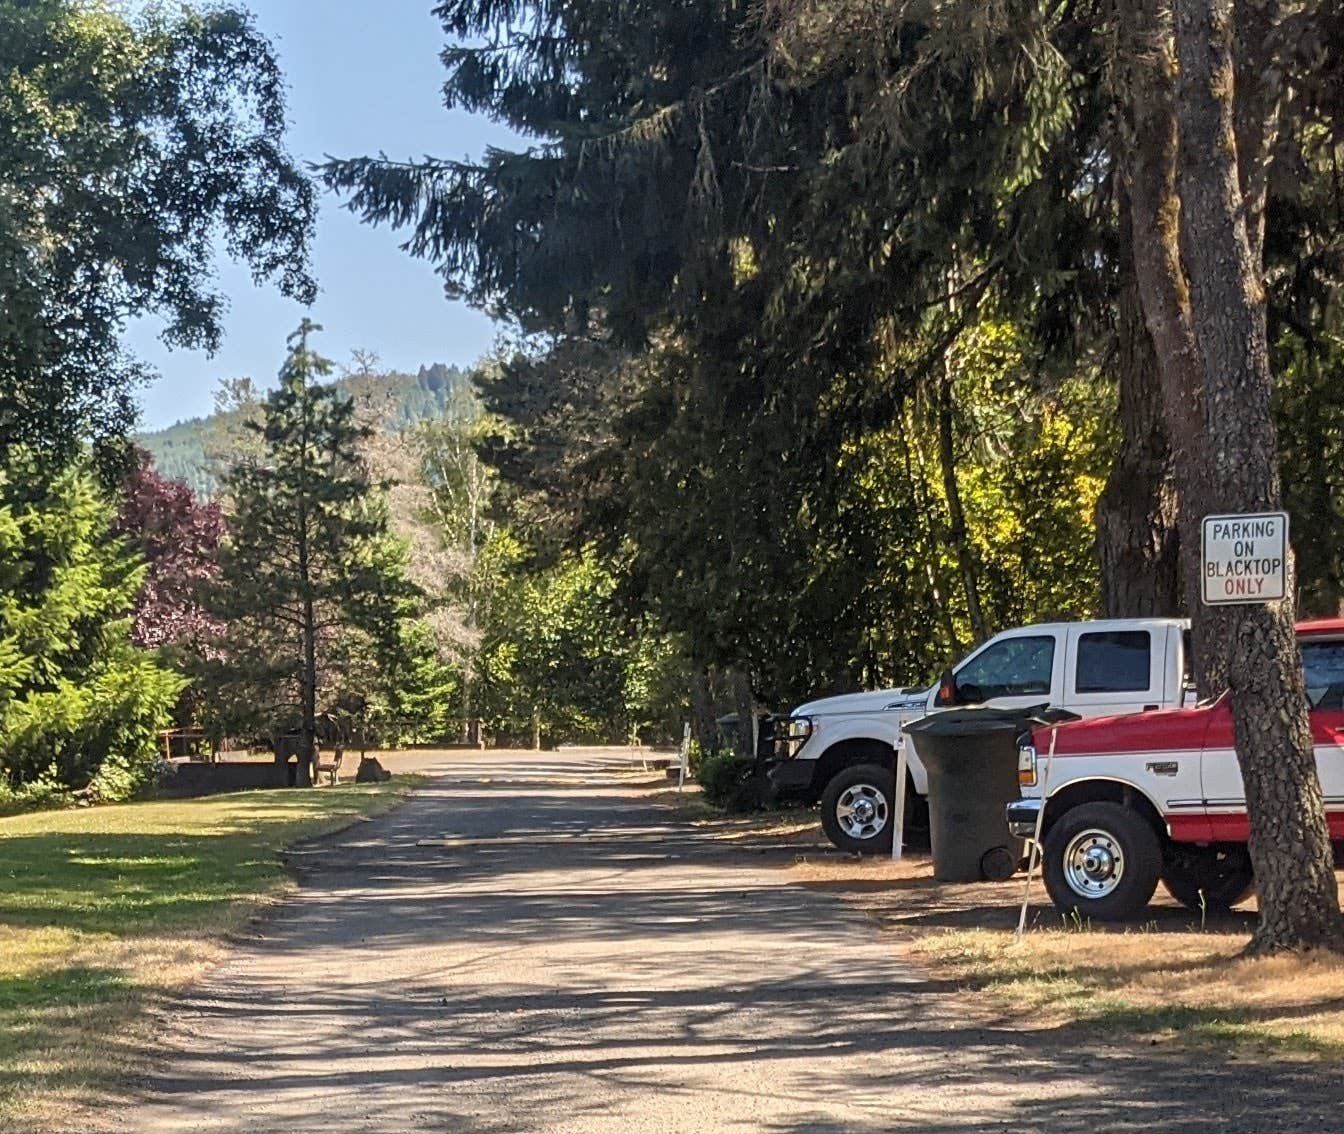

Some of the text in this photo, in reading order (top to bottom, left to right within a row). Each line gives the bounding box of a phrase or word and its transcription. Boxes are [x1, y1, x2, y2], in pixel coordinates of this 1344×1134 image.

[1213, 521, 1275, 540] PARKING
[1234, 541, 1254, 557] ON
[1207, 558, 1281, 577] BLACKTOP
[1224, 577, 1264, 595] ONLY
